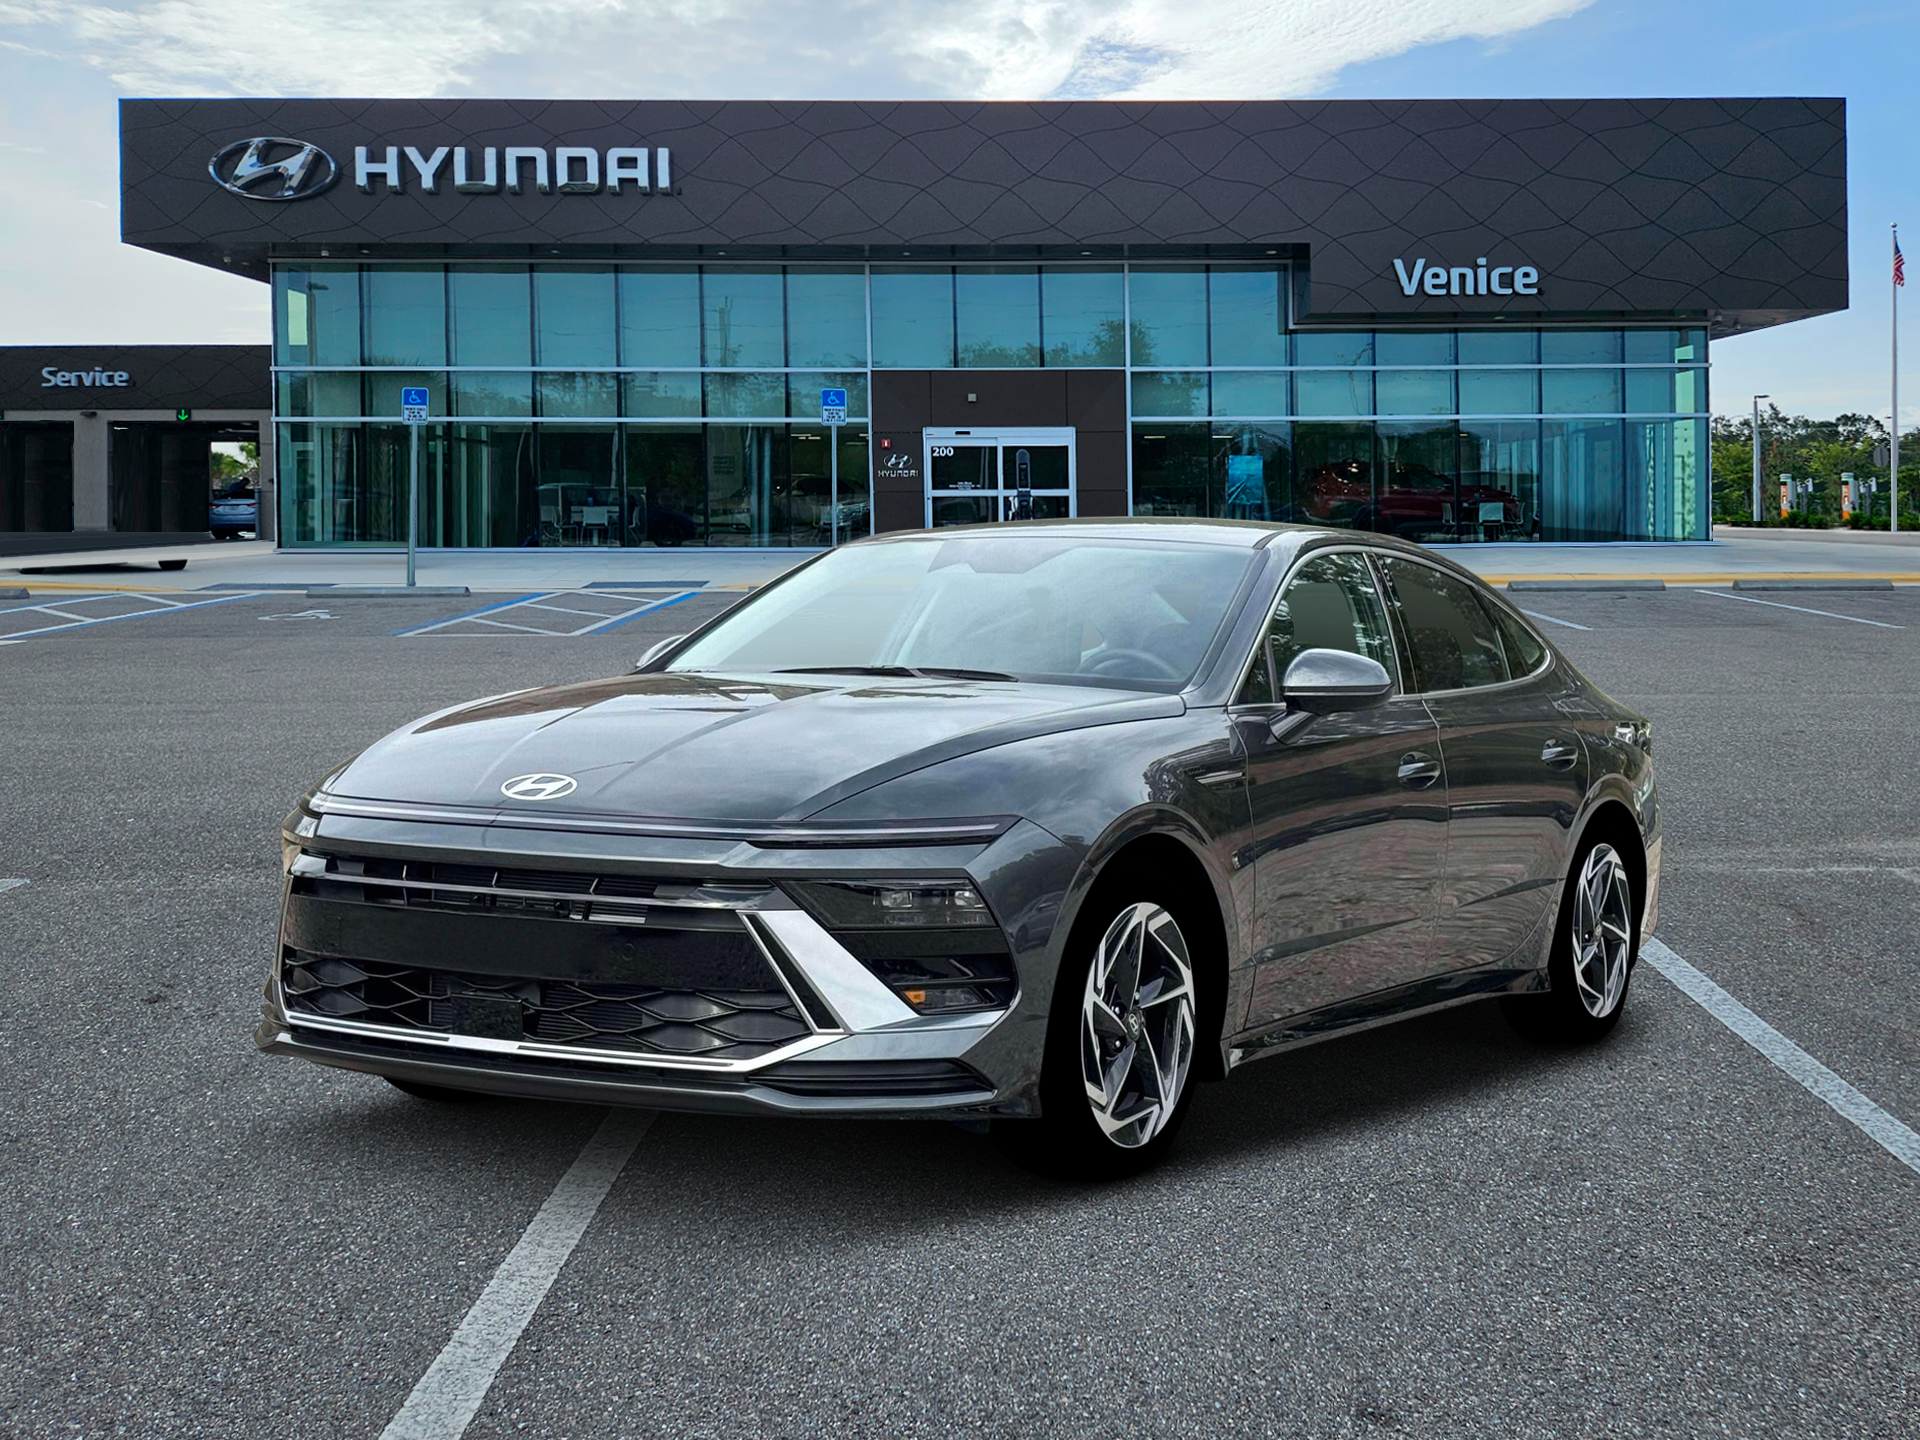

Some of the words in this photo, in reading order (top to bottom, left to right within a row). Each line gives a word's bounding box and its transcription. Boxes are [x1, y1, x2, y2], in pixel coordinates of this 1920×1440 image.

[354, 145, 670, 195] HYUNDAI
[1393, 256, 1539, 296] Venice
[41, 366, 130, 387] Service
[932, 446, 954, 457] 200
[877, 469, 919, 477] HYUNDAI
